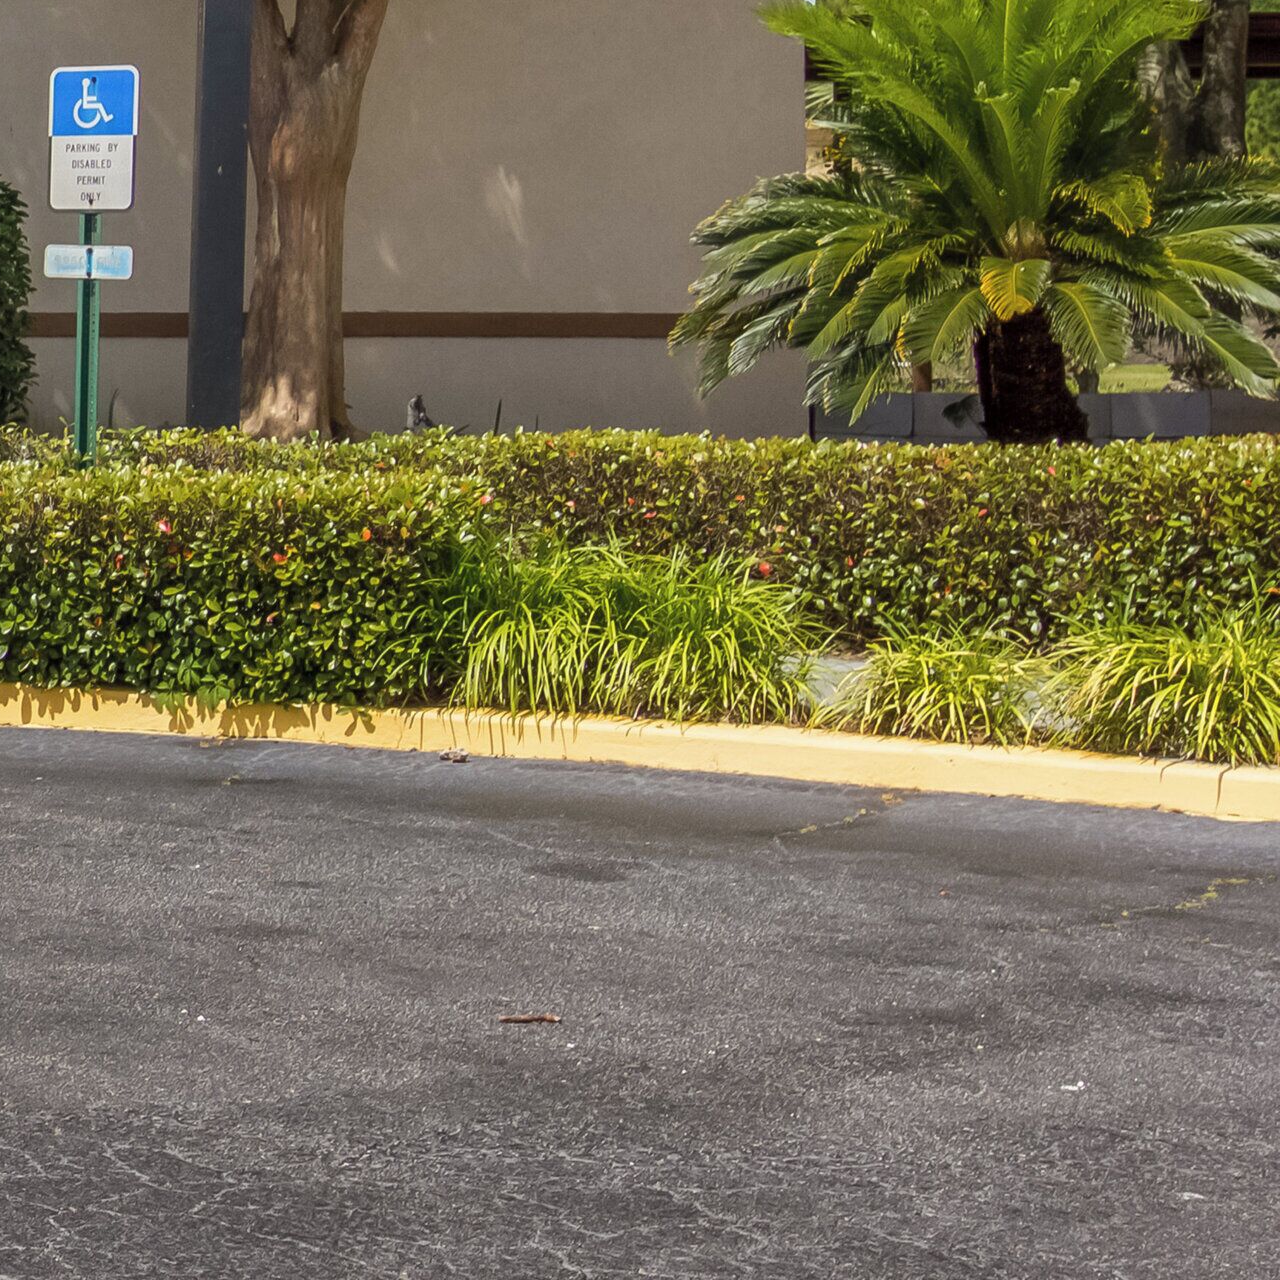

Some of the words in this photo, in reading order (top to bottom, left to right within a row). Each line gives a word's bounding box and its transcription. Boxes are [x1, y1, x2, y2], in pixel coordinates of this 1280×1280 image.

[65, 143, 101, 153] PARKING
[107, 142, 119, 153] BY
[71, 159, 112, 169] DISABLED
[76, 175, 106, 185] PERMIT
[80, 192, 101, 201] ONLY
